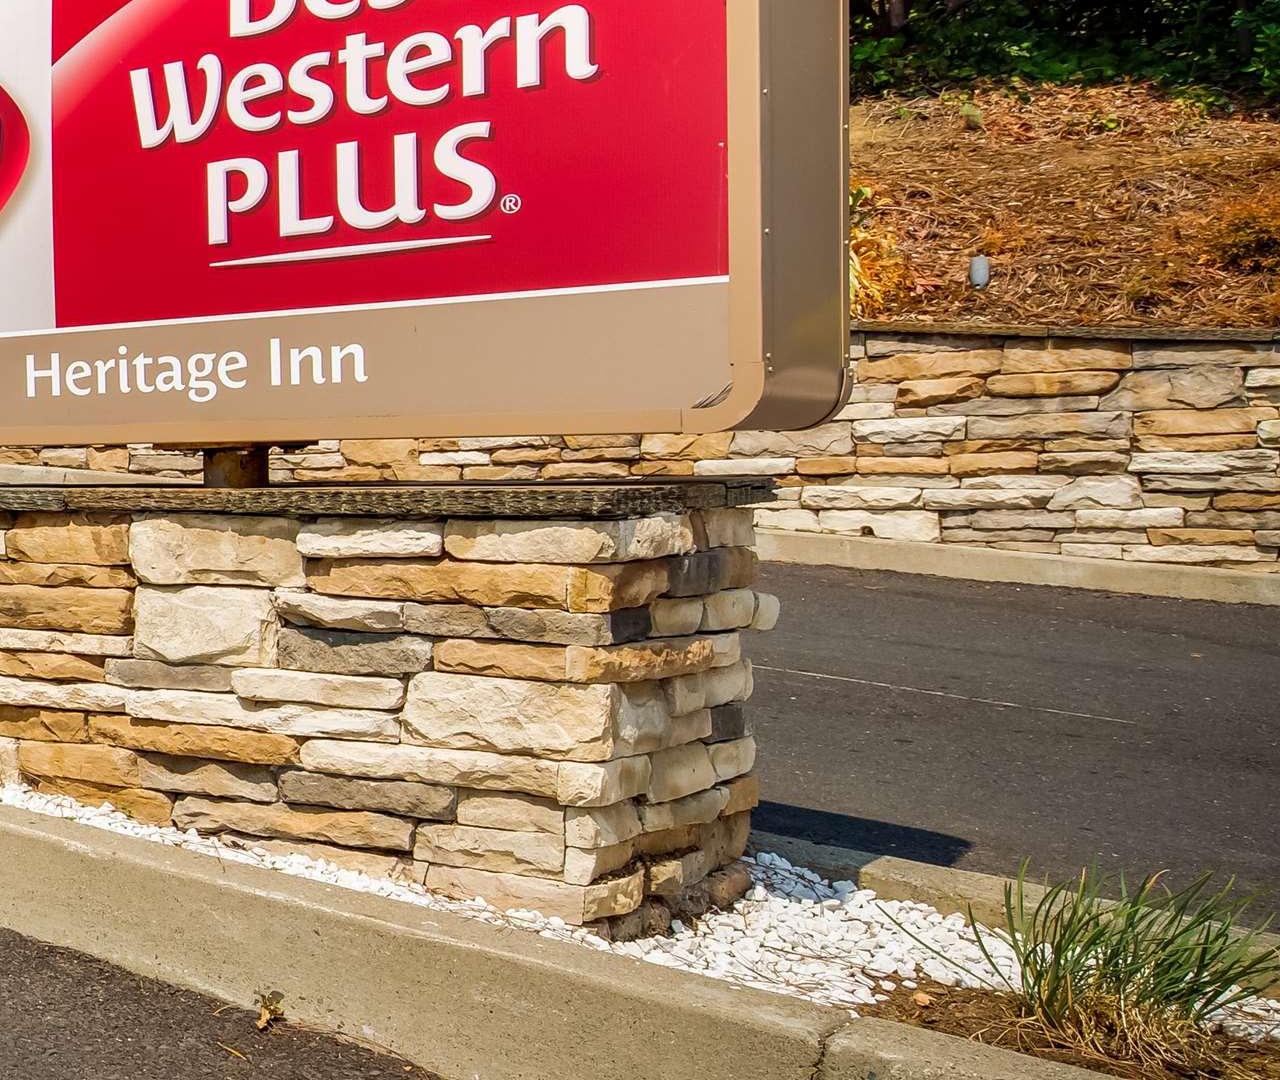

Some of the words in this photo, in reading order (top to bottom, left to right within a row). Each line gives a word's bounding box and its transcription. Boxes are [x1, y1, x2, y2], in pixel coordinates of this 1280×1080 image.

[129, 4, 600, 149] Western
[25, 345, 248, 403] Heritage
[269, 337, 369, 387] Inn
